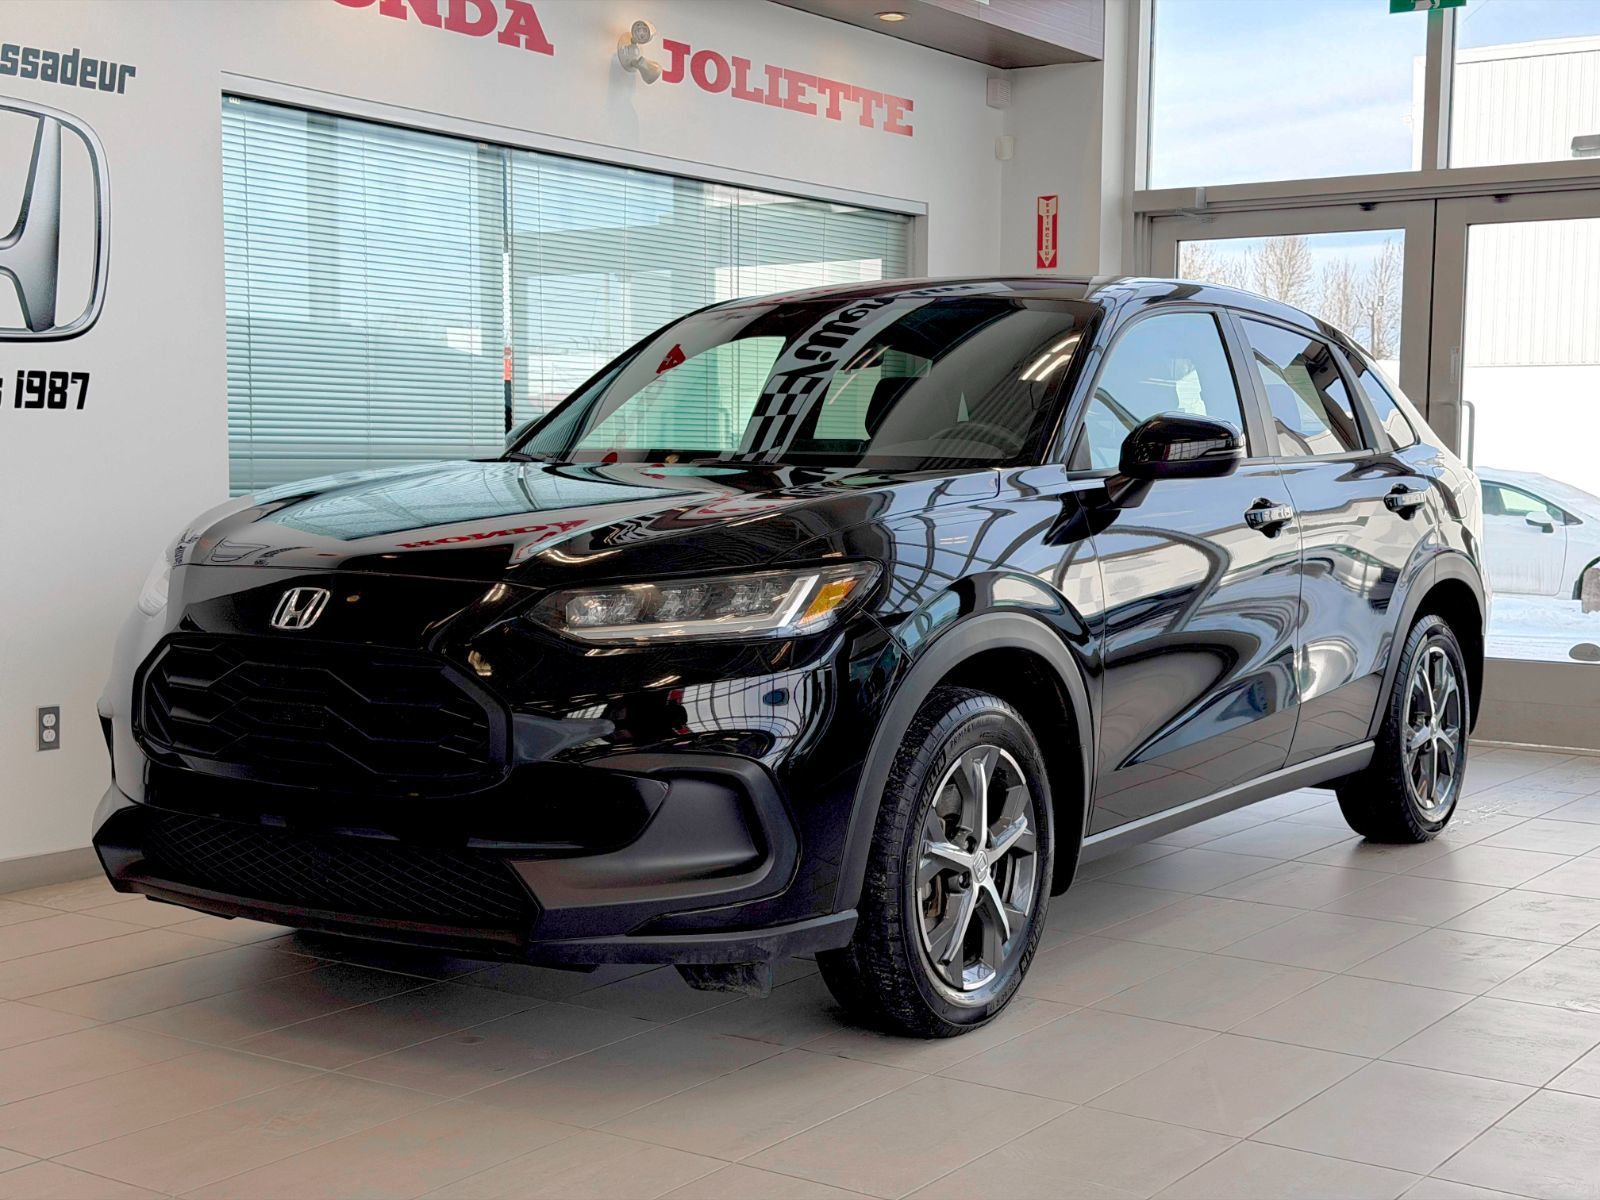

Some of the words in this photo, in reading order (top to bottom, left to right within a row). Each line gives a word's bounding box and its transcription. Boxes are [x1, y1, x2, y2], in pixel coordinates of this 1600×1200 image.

[0, 43, 137, 95] ssadeur
[661, 38, 914, 137] JOLIETTE
[14, 369, 91, 410] 1987
